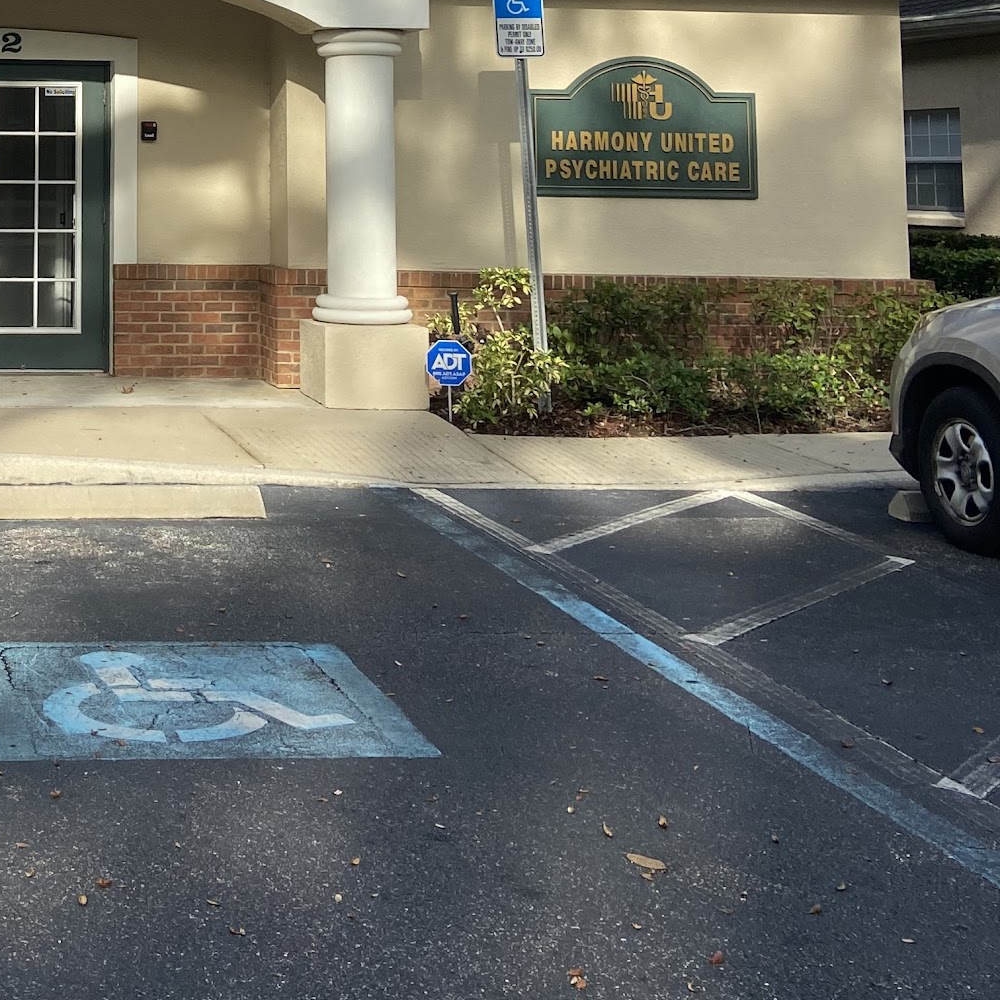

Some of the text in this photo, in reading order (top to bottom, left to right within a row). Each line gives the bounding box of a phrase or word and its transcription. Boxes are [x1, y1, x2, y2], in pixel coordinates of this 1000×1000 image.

[551, 130, 735, 154] HARMONY UNITED
[545, 158, 741, 182] PSYCHIATRIC CARE
[431, 353, 466, 370] ADT
